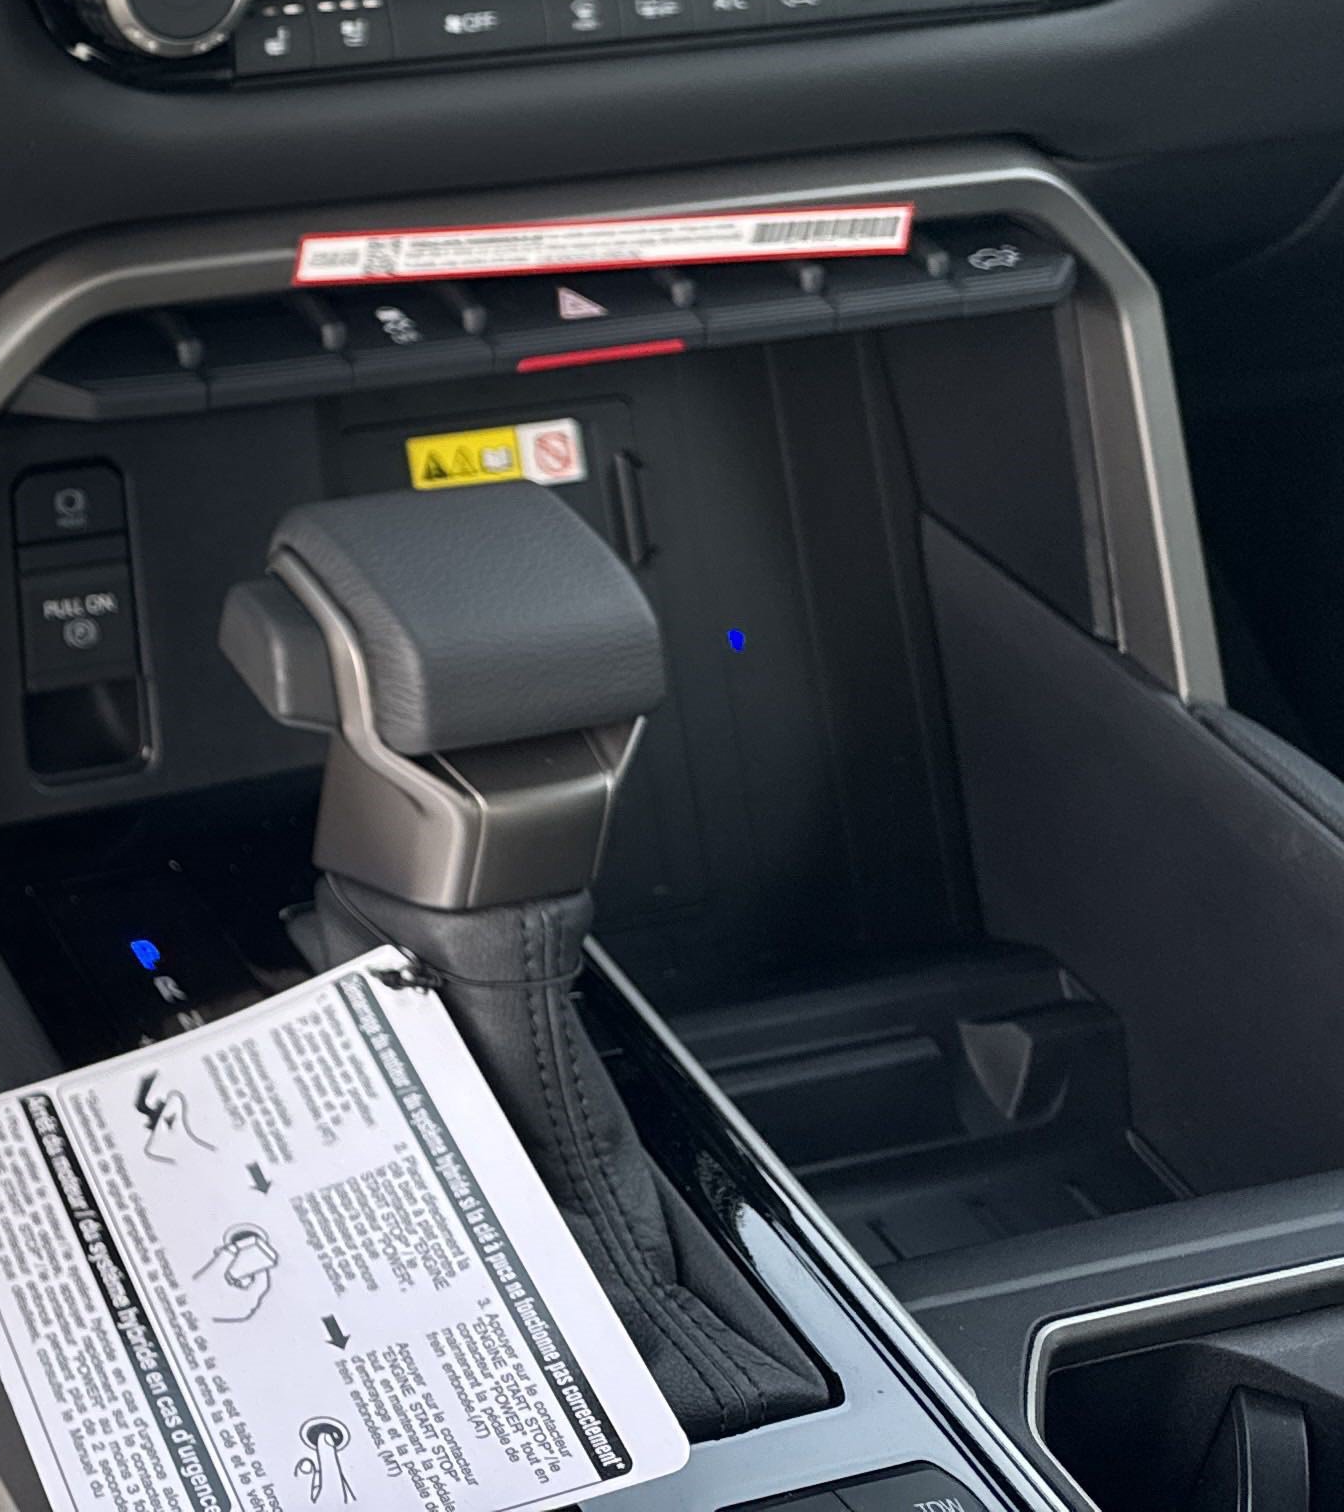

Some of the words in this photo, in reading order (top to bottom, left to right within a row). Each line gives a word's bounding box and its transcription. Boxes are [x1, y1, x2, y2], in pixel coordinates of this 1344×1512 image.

[130, 939, 161, 970] P
[485, 1252, 517, 1283] puce
[505, 1281, 526, 1299] ne
[514, 1297, 560, 1362] fonctionne
[146, 1372, 168, 1395] en
[480, 1313, 519, 1359] Appuyer
[512, 1362, 531, 1381] sur
[524, 1384, 538, 1397] le
[533, 1401, 573, 1458] contacteur
[544, 1361, 574, 1386] pas
[456, 1322, 494, 1379] contacteur
[520, 1441, 542, 1466] tout
[534, 1468, 550, 1484] en
[475, 1390, 488, 1403] la
[500, 1372, 531, 1411] START
[156, 1396, 183, 1428] cas
[380, 1378, 394, 1394] en
[388, 1394, 427, 1455] maintenant
[421, 1458, 434, 1471] la
[395, 1342, 427, 1387] Appuyer
[421, 1392, 439, 1410] sur
[432, 1411, 445, 1424] le
[440, 1427, 479, 1486] contacteur
[409, 1401, 439, 1440] START
[480, 1406, 511, 1446] pédale
[387, 1428, 402, 1440] et
[395, 1443, 409, 1457] la
[504, 1447, 520, 1463] de
[171, 1429, 221, 1512] d'urgence
[251, 1460, 266, 1478] ou
[401, 1460, 431, 1499] pédale
[126, 1484, 140, 1495] 3
